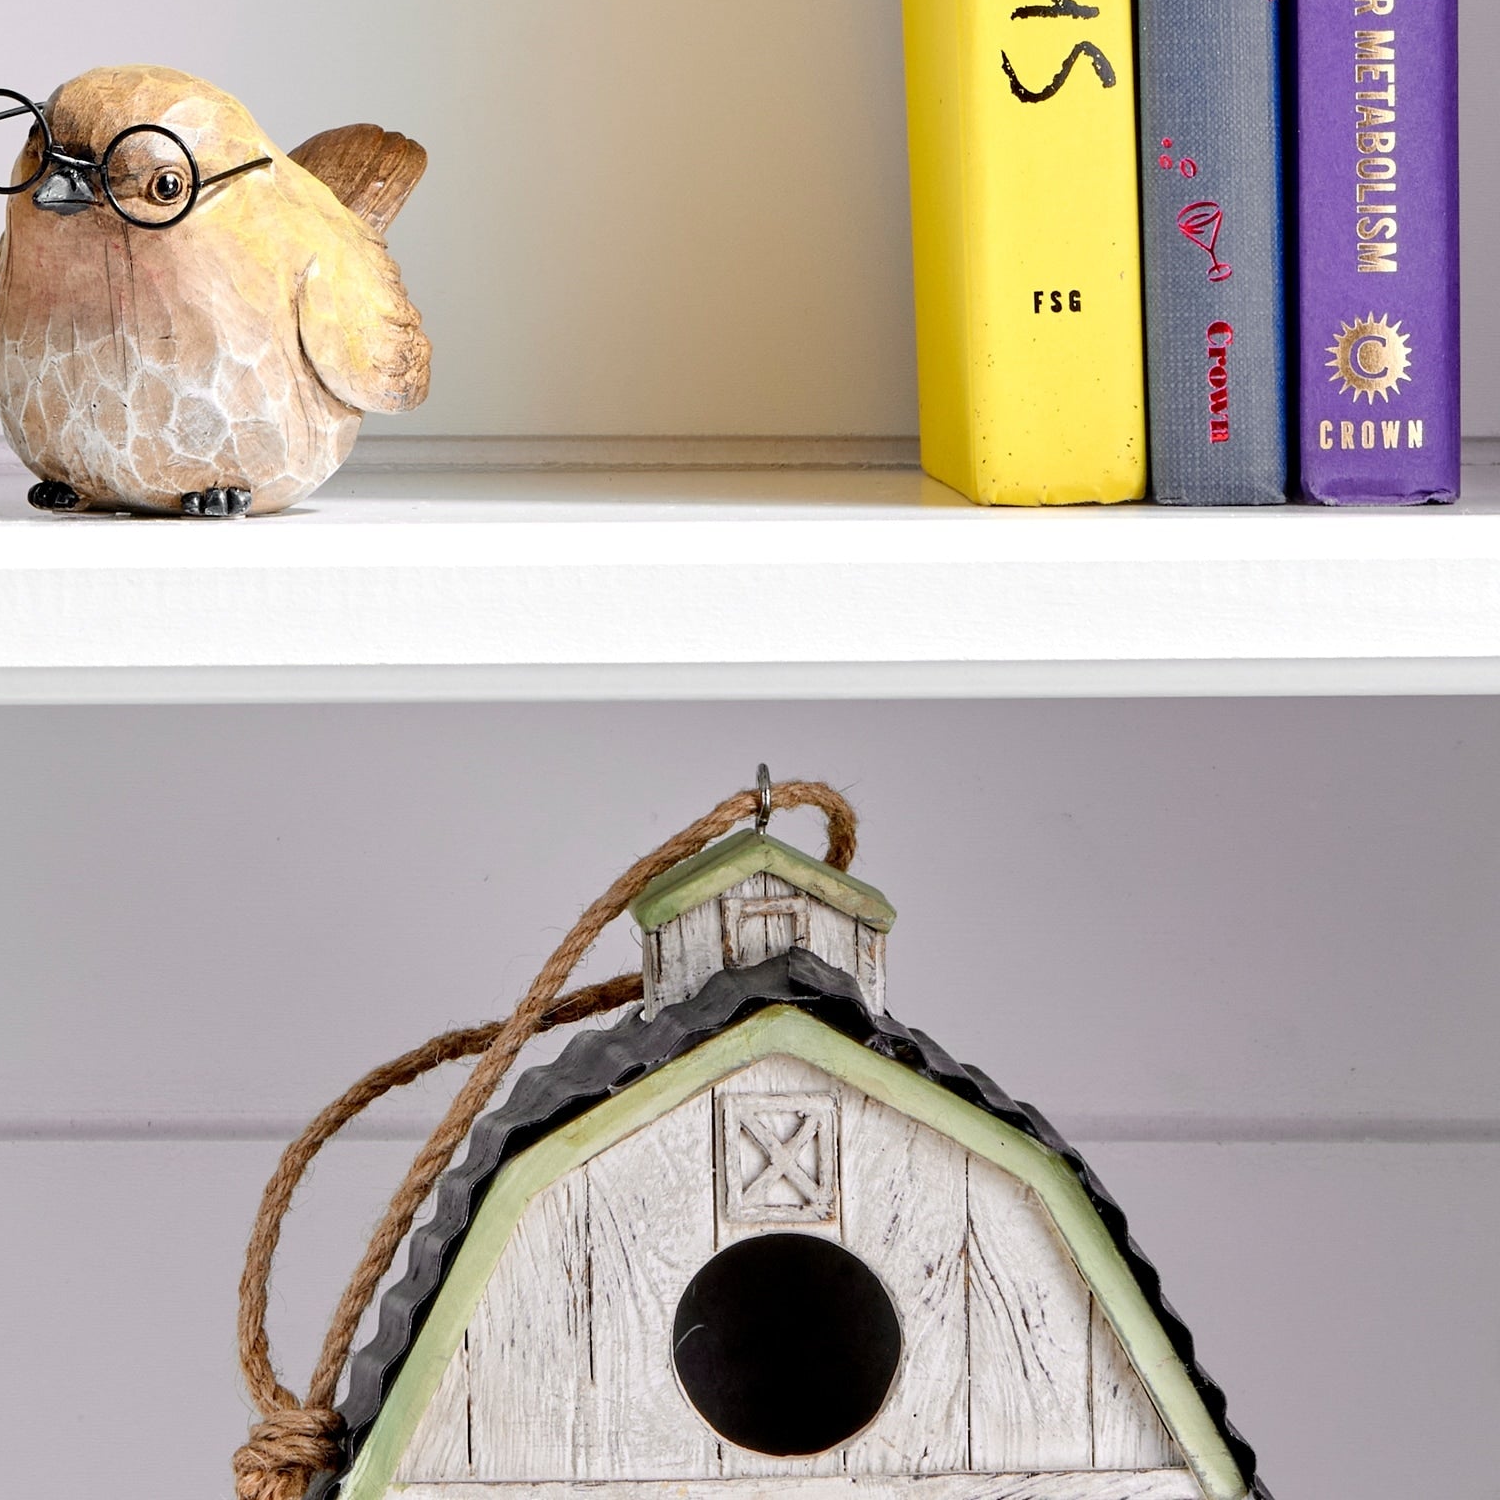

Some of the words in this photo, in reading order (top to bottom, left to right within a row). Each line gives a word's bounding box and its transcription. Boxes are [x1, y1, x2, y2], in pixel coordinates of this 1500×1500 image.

[1354, 29, 1399, 275] METABOLISM
[1033, 289, 1082, 313] FSG
[1205, 320, 1234, 444] Crown
[1319, 420, 1423, 449] CROWN
